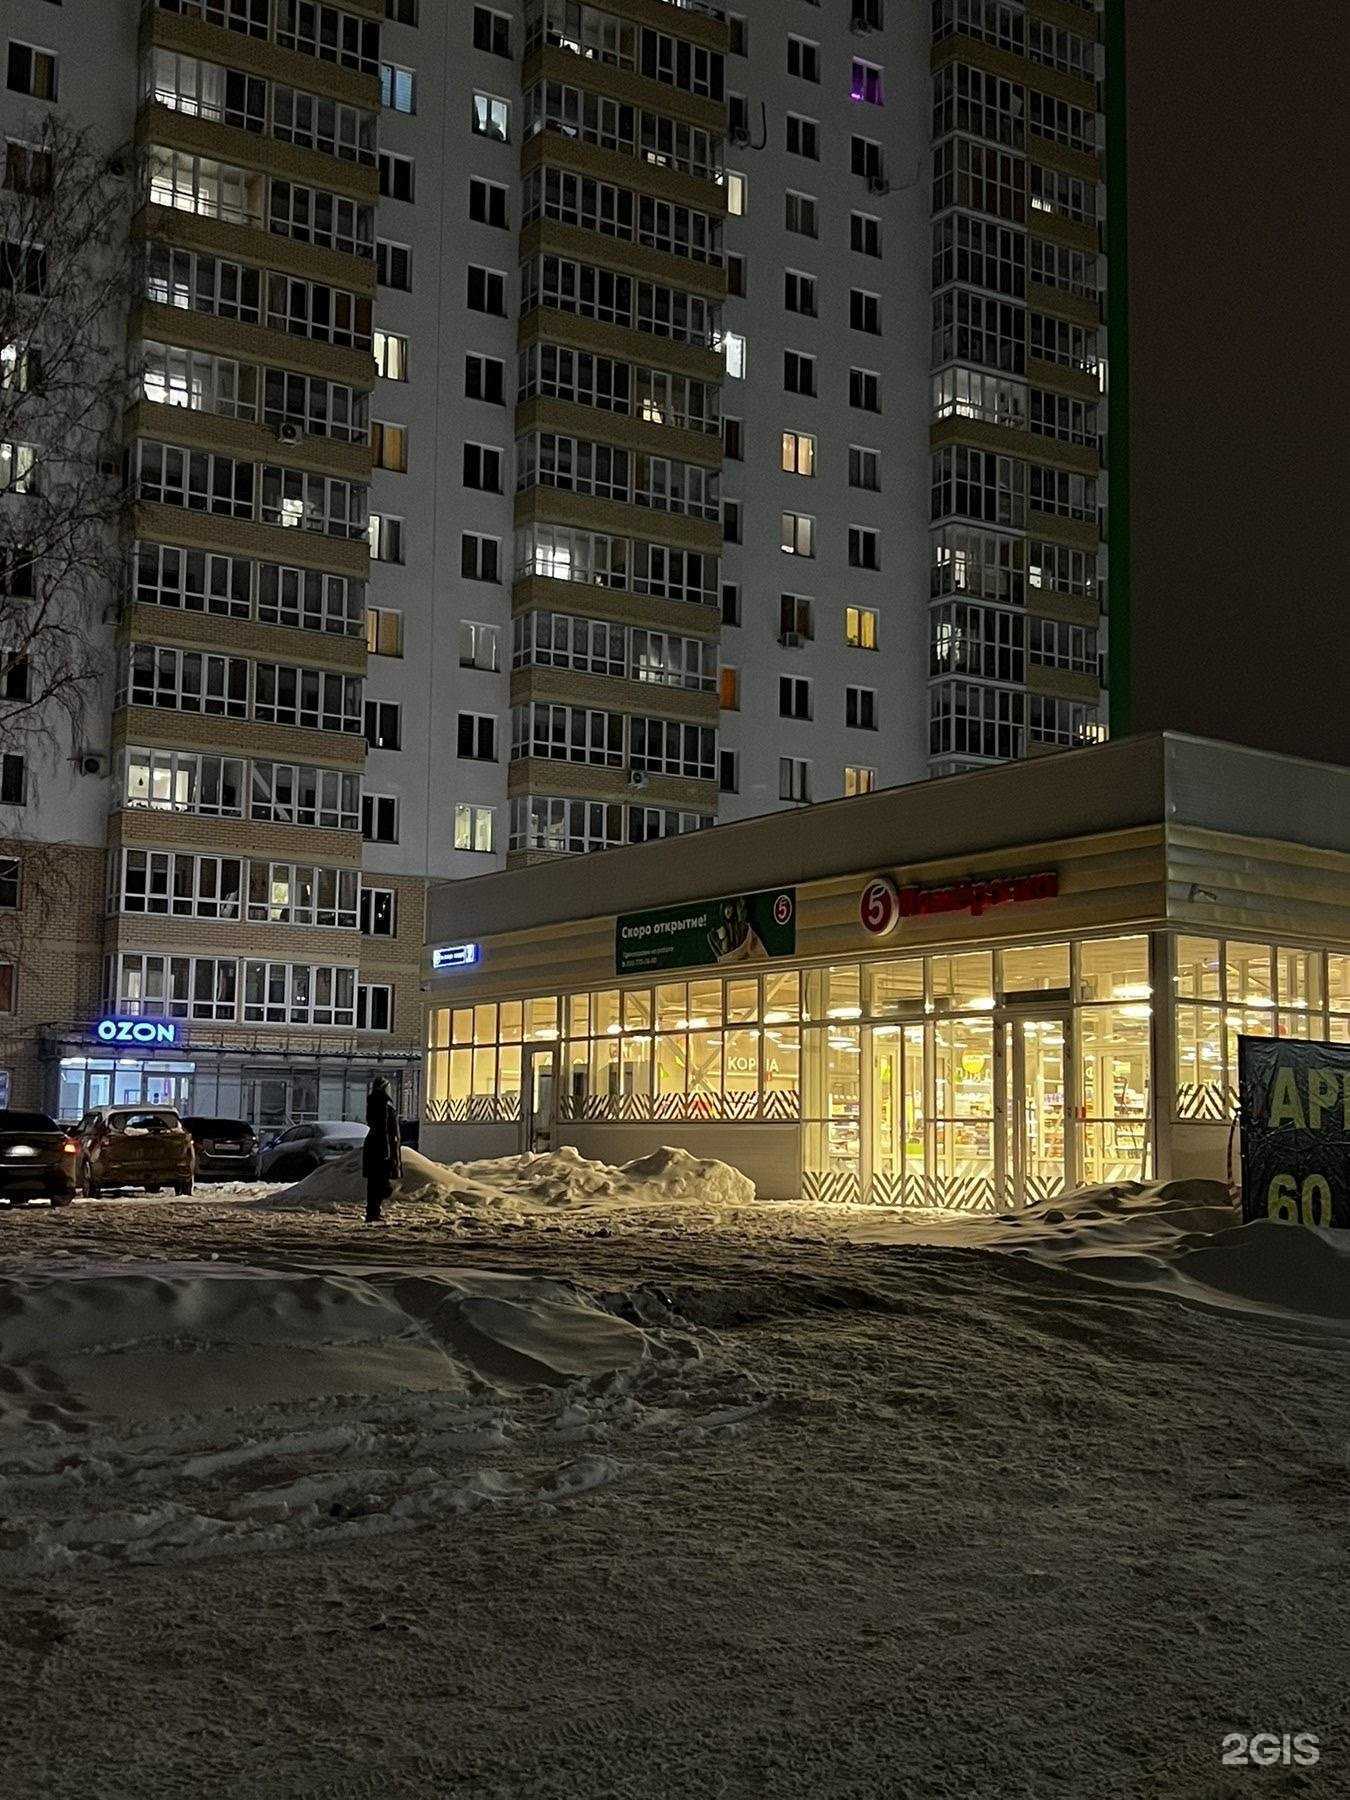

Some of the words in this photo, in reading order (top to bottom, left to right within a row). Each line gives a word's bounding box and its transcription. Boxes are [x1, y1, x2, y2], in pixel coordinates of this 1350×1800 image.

[621, 925, 651, 940] Скоро
[653, 914, 707, 936] открытие!
[98, 1020, 175, 1043] OZON
[728, 1056, 779, 1072] КОРА
[1268, 1173, 1331, 1228] 60
